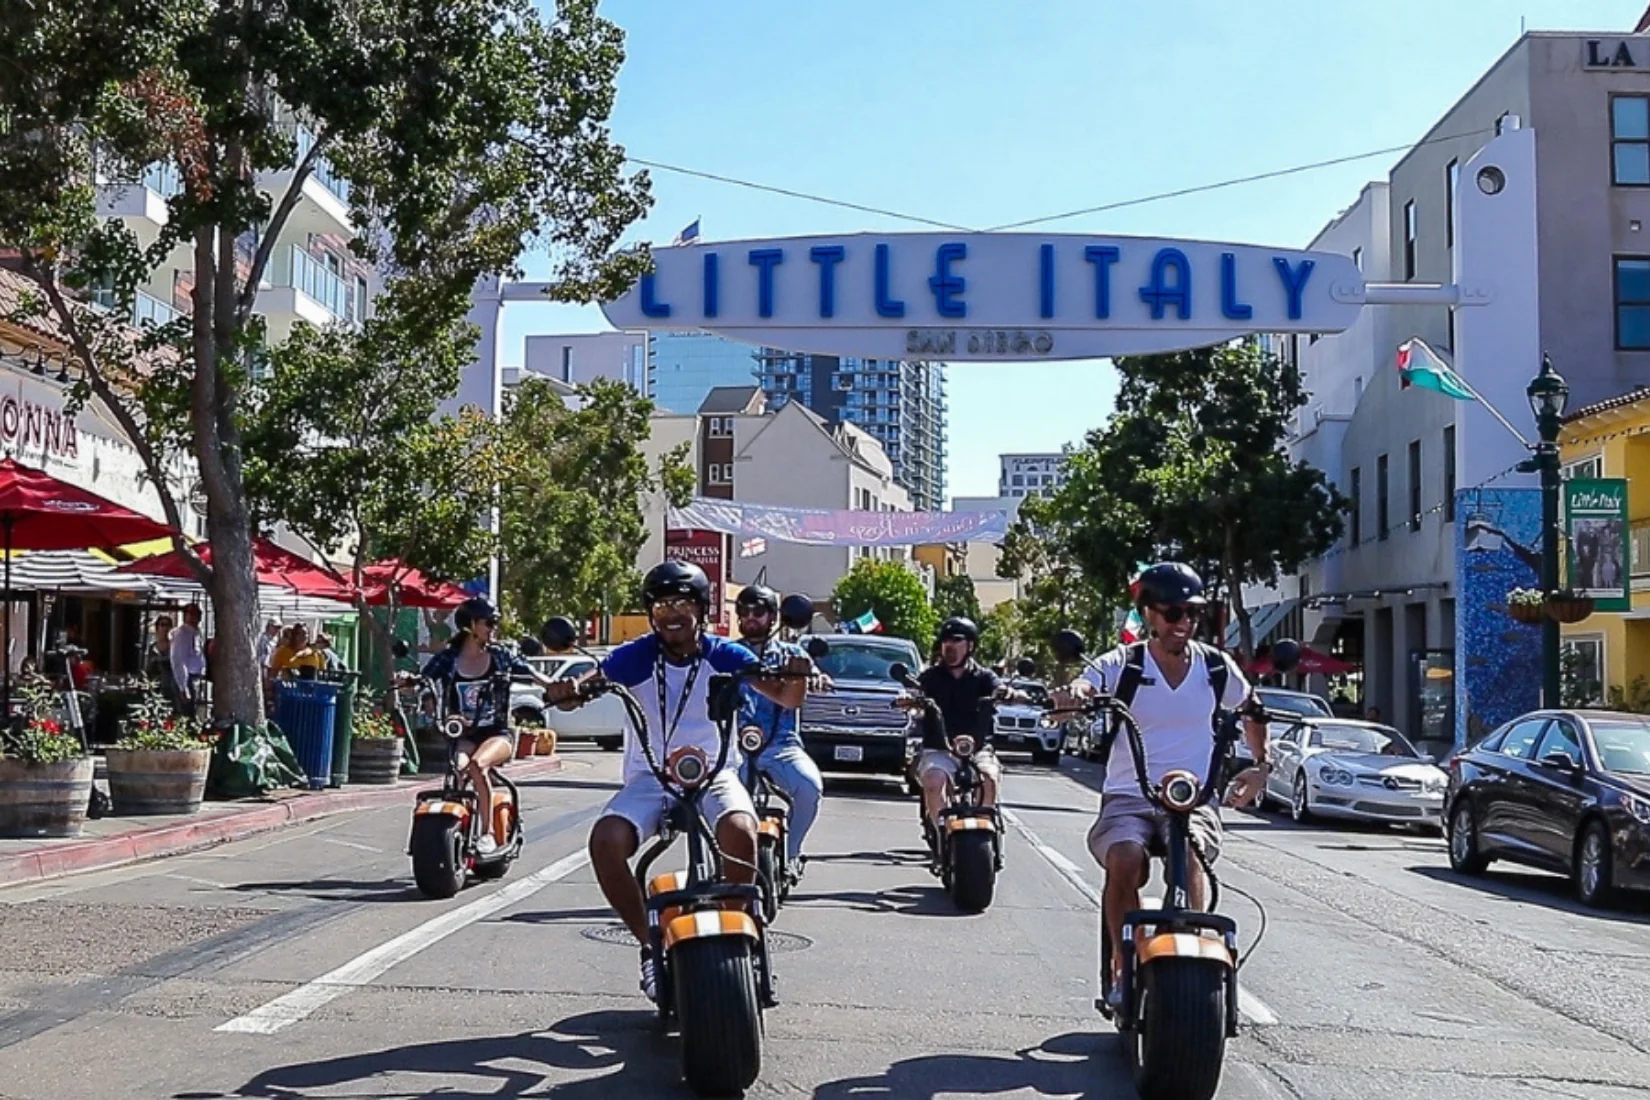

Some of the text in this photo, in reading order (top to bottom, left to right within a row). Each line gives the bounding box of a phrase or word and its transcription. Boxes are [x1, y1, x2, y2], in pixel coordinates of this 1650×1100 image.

[1587, 40, 1636, 66] LA
[641, 243, 1317, 320] LITTLE ITALY
[907, 329, 1054, 353] SAN DIEGO
[667, 545, 720, 559] PRINCESS
